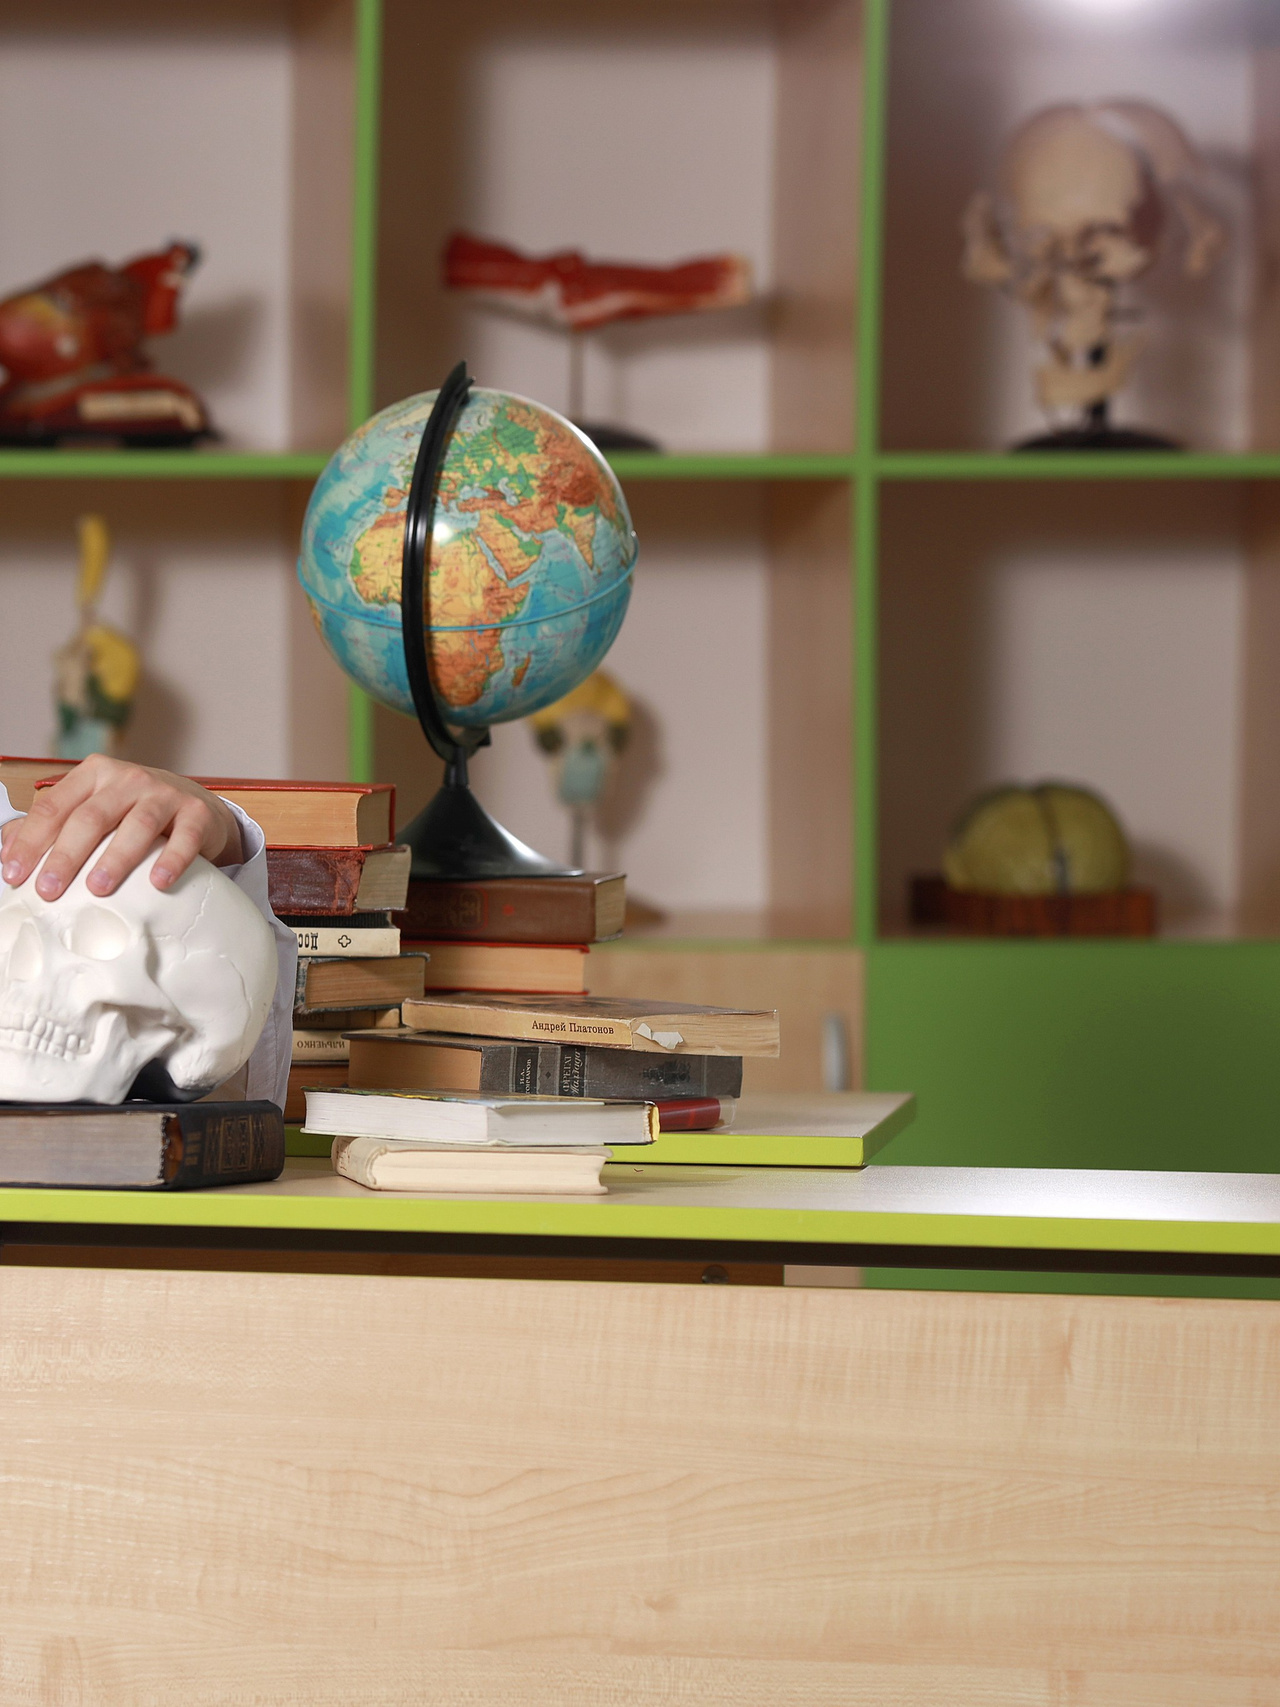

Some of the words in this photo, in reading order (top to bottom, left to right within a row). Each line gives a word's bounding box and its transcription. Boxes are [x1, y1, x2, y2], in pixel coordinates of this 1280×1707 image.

[532, 1021, 566, 1033] Андрей
[569, 1023, 614, 1034] Платонов
[297, 1041, 345, 1049] ИЛЬЧЕНКО
[562, 1055, 572, 1092] ФРЕГАТ
